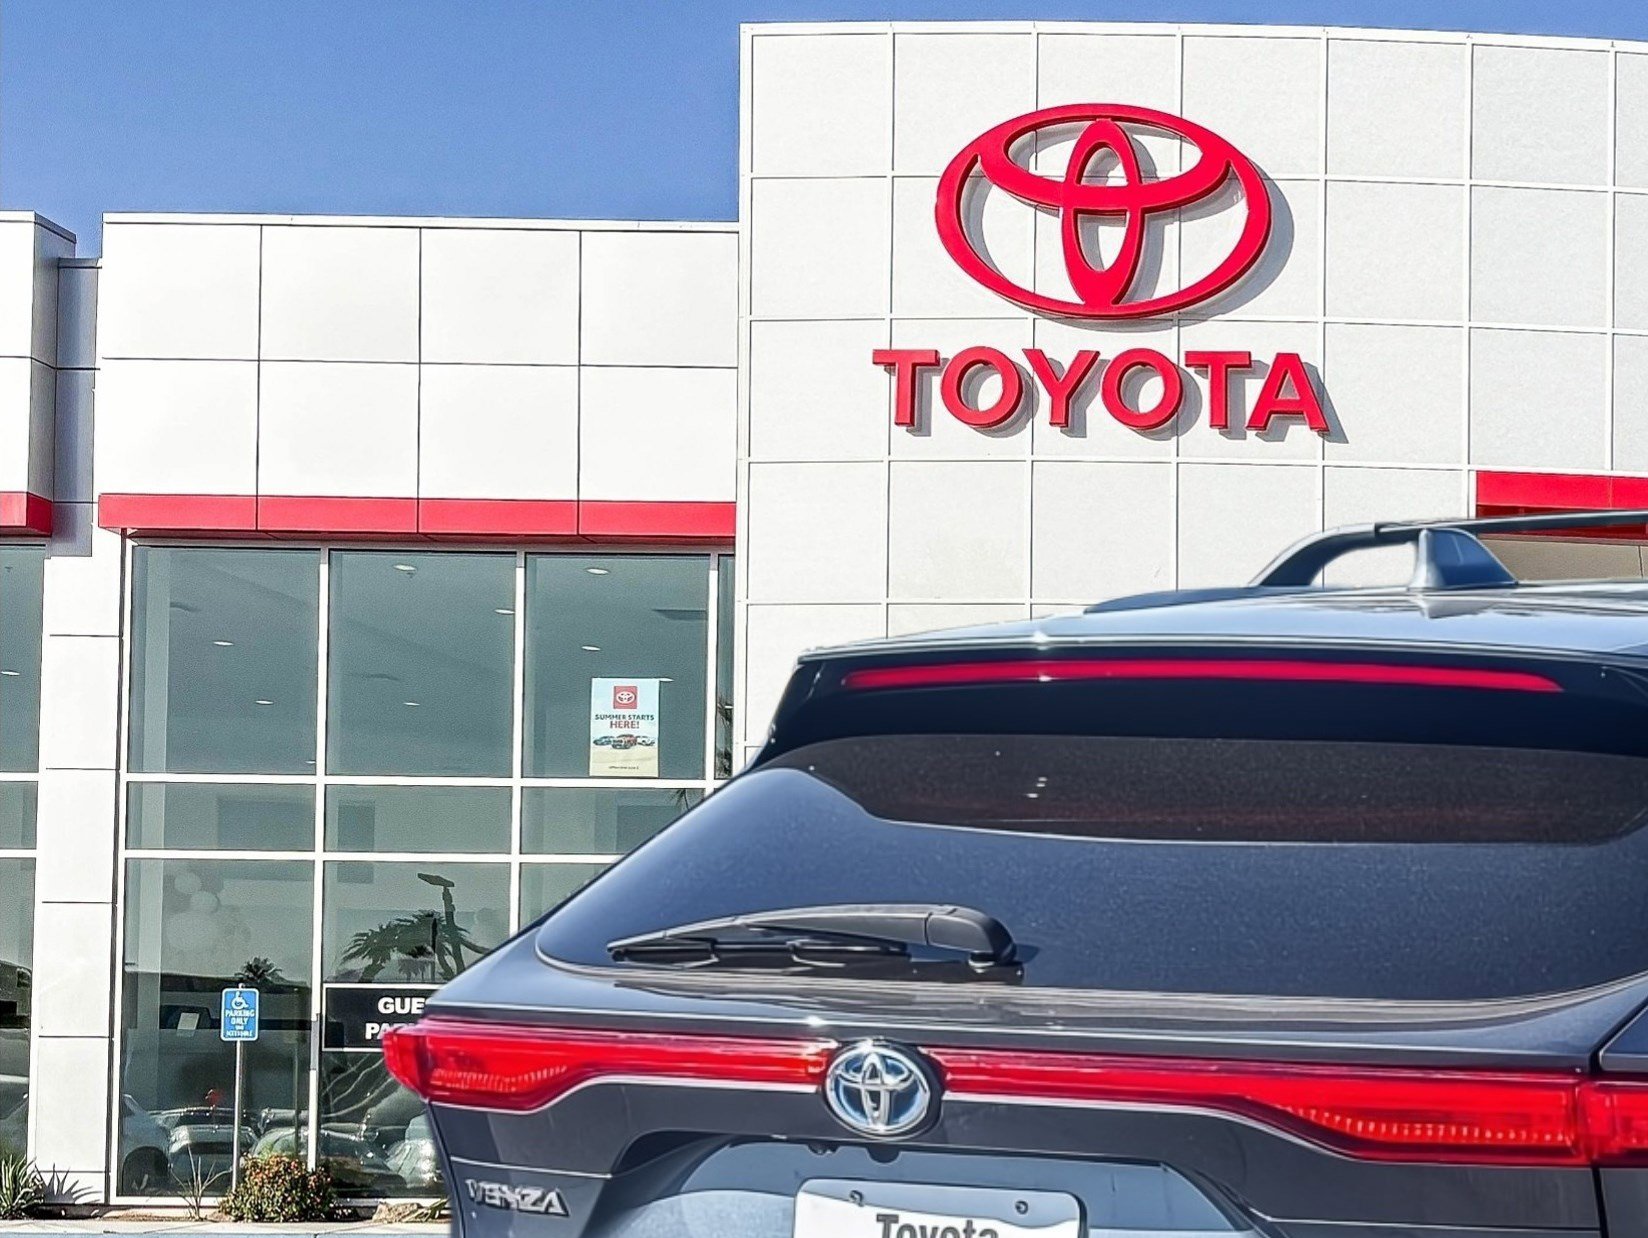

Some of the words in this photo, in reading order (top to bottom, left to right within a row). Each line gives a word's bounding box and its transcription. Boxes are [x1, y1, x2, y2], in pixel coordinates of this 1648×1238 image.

[872, 346, 1331, 434] TOYOTA
[610, 720, 640, 729] HERE!
[377, 996, 426, 1015] GUE
[465, 1179, 570, 1216] VENZA
